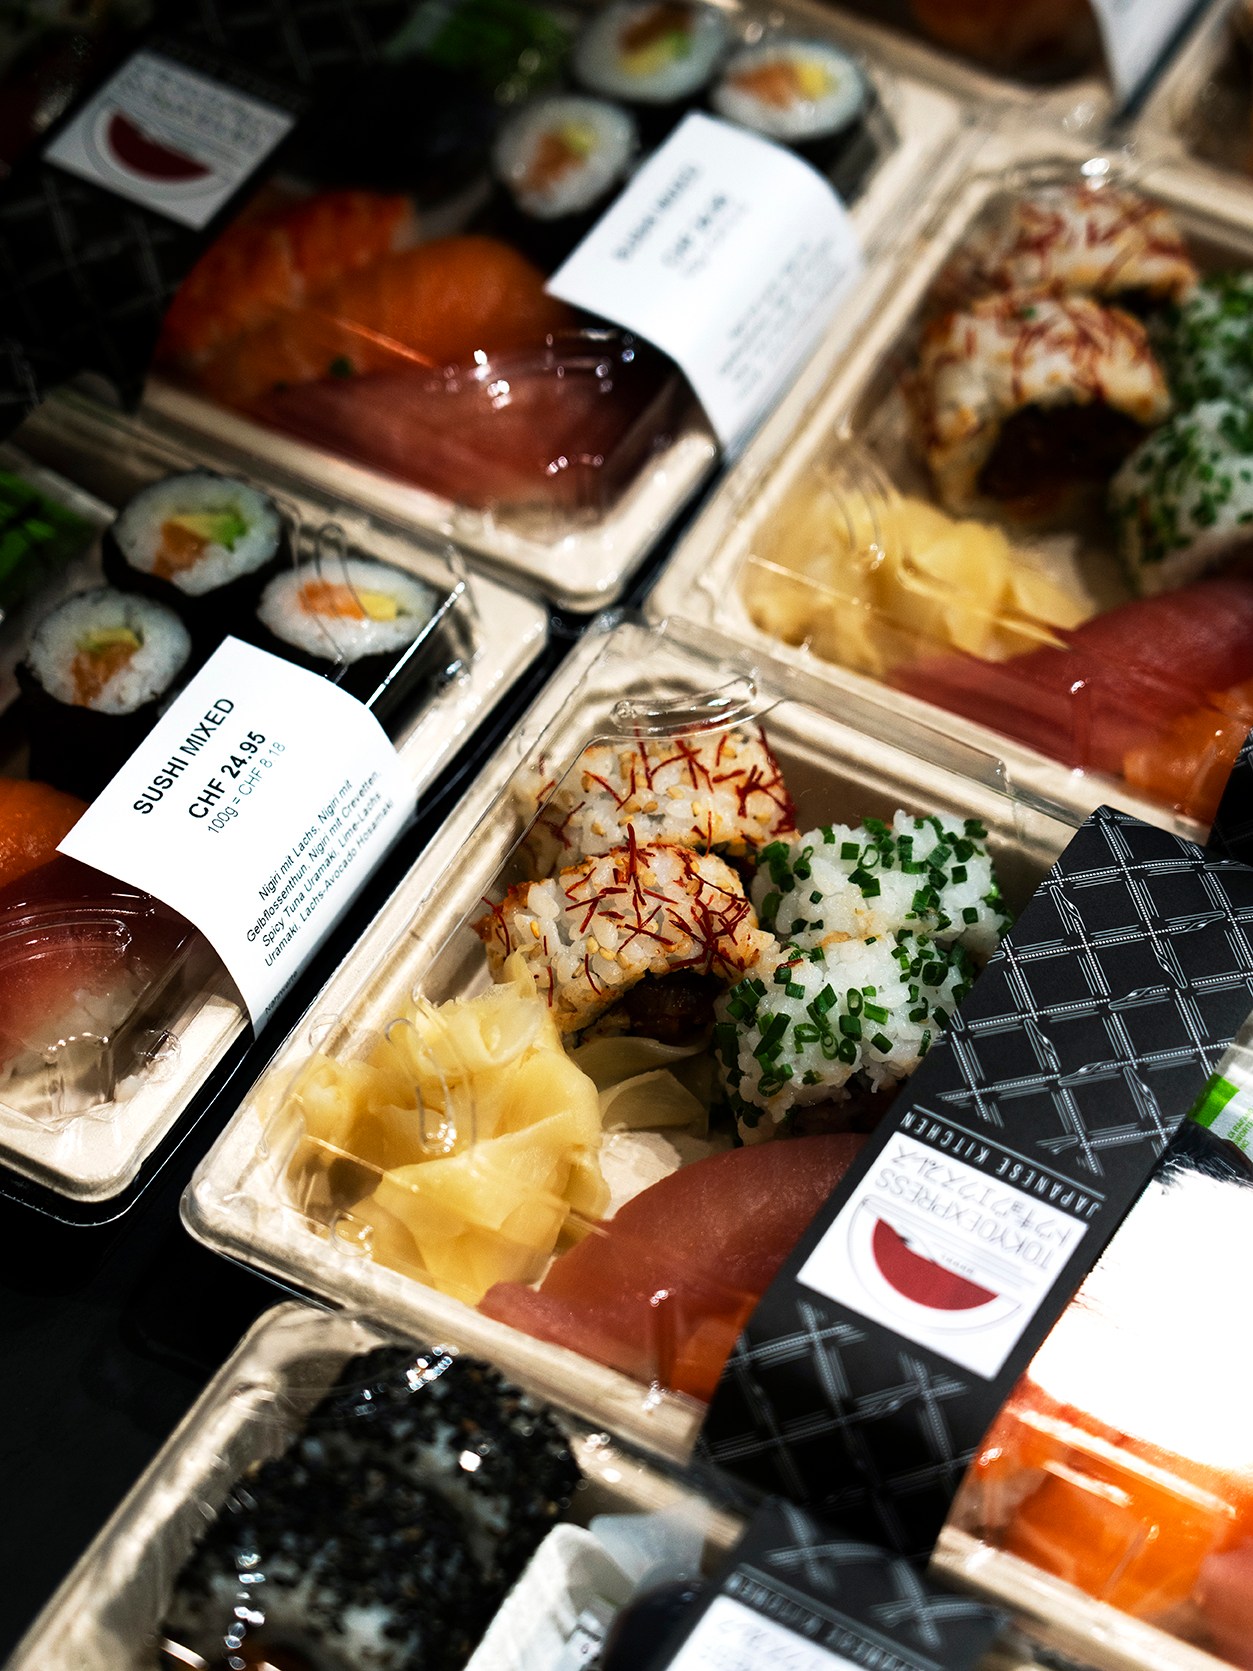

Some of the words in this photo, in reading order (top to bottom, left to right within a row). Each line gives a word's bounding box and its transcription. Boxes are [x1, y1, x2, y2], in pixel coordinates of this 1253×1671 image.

[133, 756, 189, 814] SUSHI
[179, 698, 234, 756] MIXED
[188, 778, 225, 818] CHF
[221, 731, 266, 779] 24.95
[207, 806, 239, 834] 100g
[232, 796, 241, 805] =
[238, 766, 263, 796] CHF
[246, 864, 311, 942] Gelbflossenthun,
[308, 834, 331, 862] Nigiri
[329, 817, 343, 837] mit
[258, 870, 282, 901] Nigiri
[280, 855, 295, 875] mit
[292, 826, 320, 857] Lachs,
[317, 797, 340, 824] Nigiri
[338, 779, 353, 799] mit
[262, 917, 285, 947] Spicy
[283, 891, 306, 918] Tuna
[303, 848, 340, 892] Uramaki,
[264, 922, 301, 967] Uramaki,
[299, 847, 358, 922] Lachs-Avocado
[900, 1110, 991, 1166] KITCHEN
[995, 1156, 1102, 1219] JAPANESE
